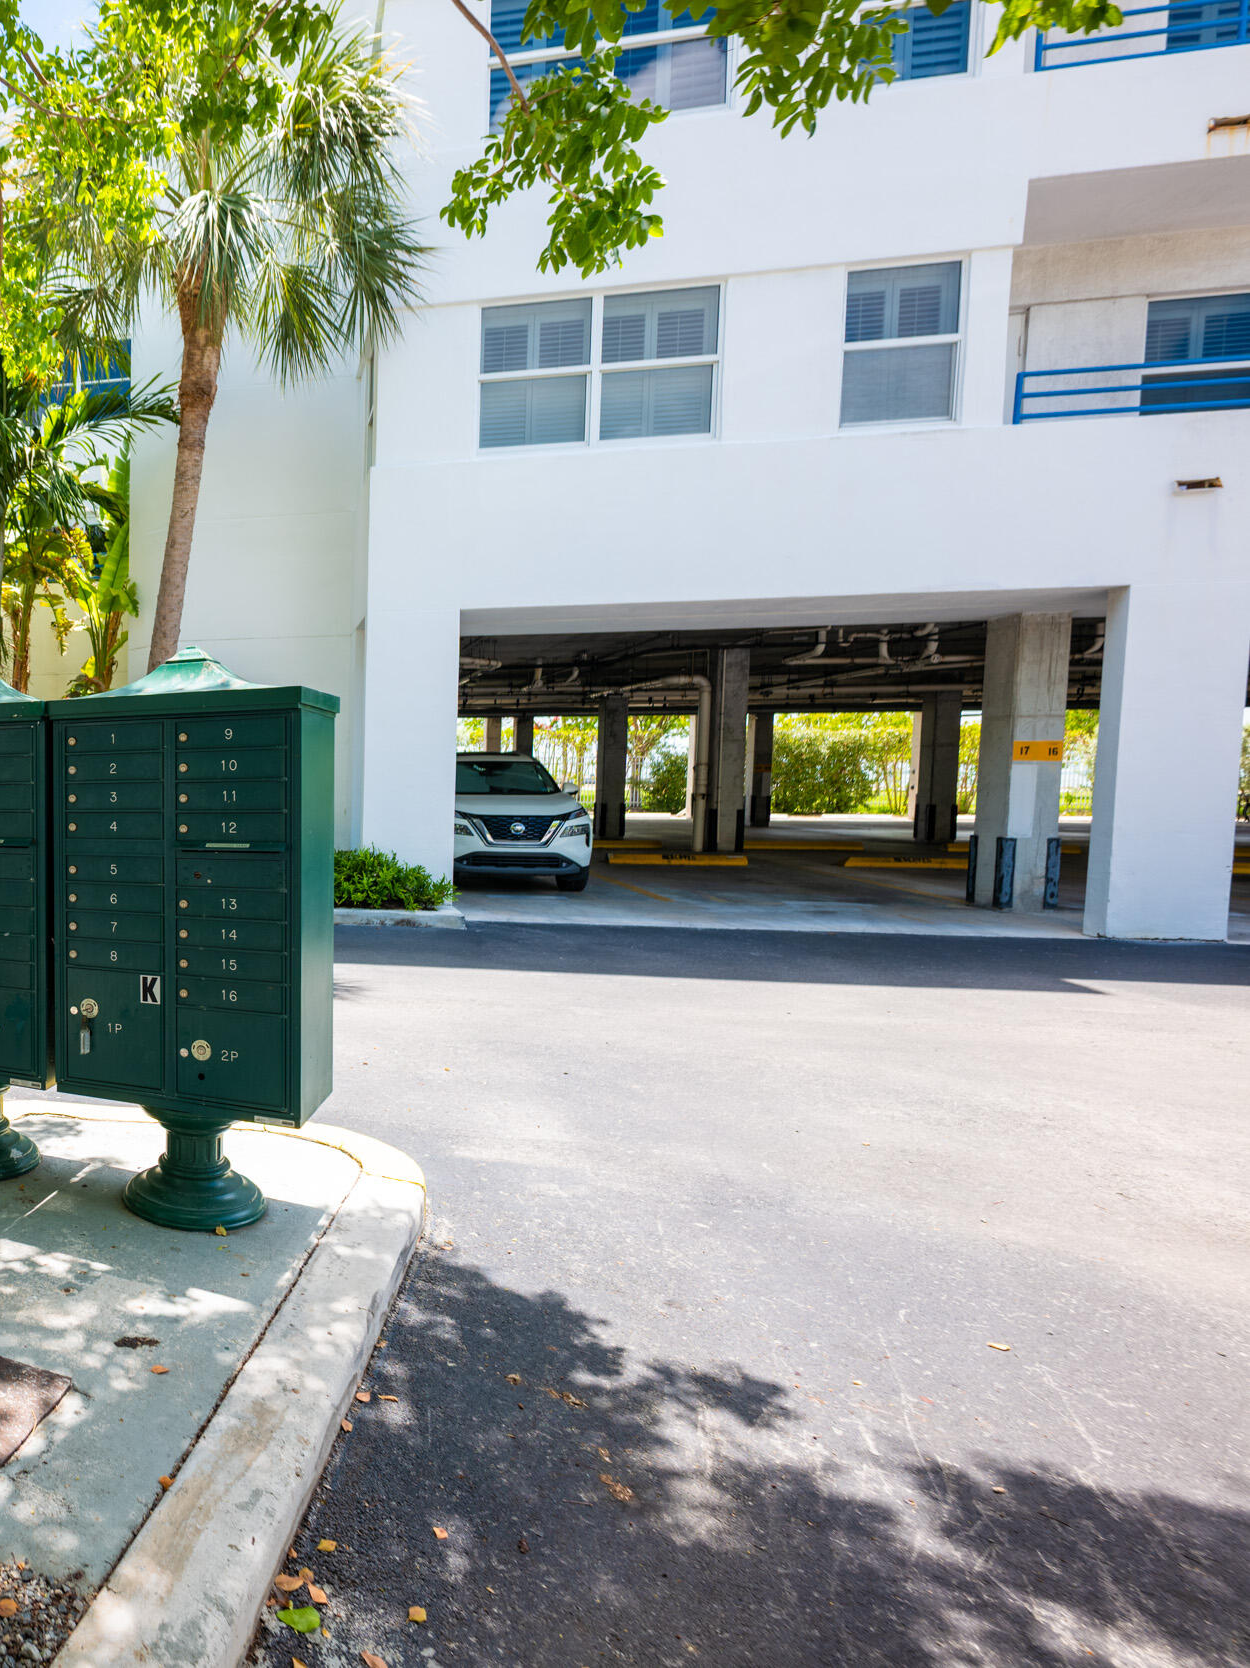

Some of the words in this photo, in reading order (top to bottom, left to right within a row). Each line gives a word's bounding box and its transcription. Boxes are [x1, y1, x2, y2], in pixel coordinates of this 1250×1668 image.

[110, 733, 116, 744] 1
[224, 729, 233, 740] 9
[1019, 745, 1030, 756] 17
[1048, 746, 1059, 757] 16
[109, 763, 117, 774] 2
[221, 760, 238, 771] 10
[109, 792, 118, 803] 3
[222, 791, 236, 802] 11
[109, 822, 118, 832] 4
[221, 822, 237, 834] 12
[109, 864, 118, 875] 5
[109, 894, 118, 904] 6
[221, 899, 238, 910] 13
[110, 922, 118, 933] 7
[221, 929, 238, 941] 14
[110, 951, 118, 962] 8
[221, 959, 238, 971] 15
[142, 976, 158, 1003] K
[221, 990, 238, 1002] 16
[107, 1024, 123, 1034] 1P
[221, 1050, 239, 1062] 2P
